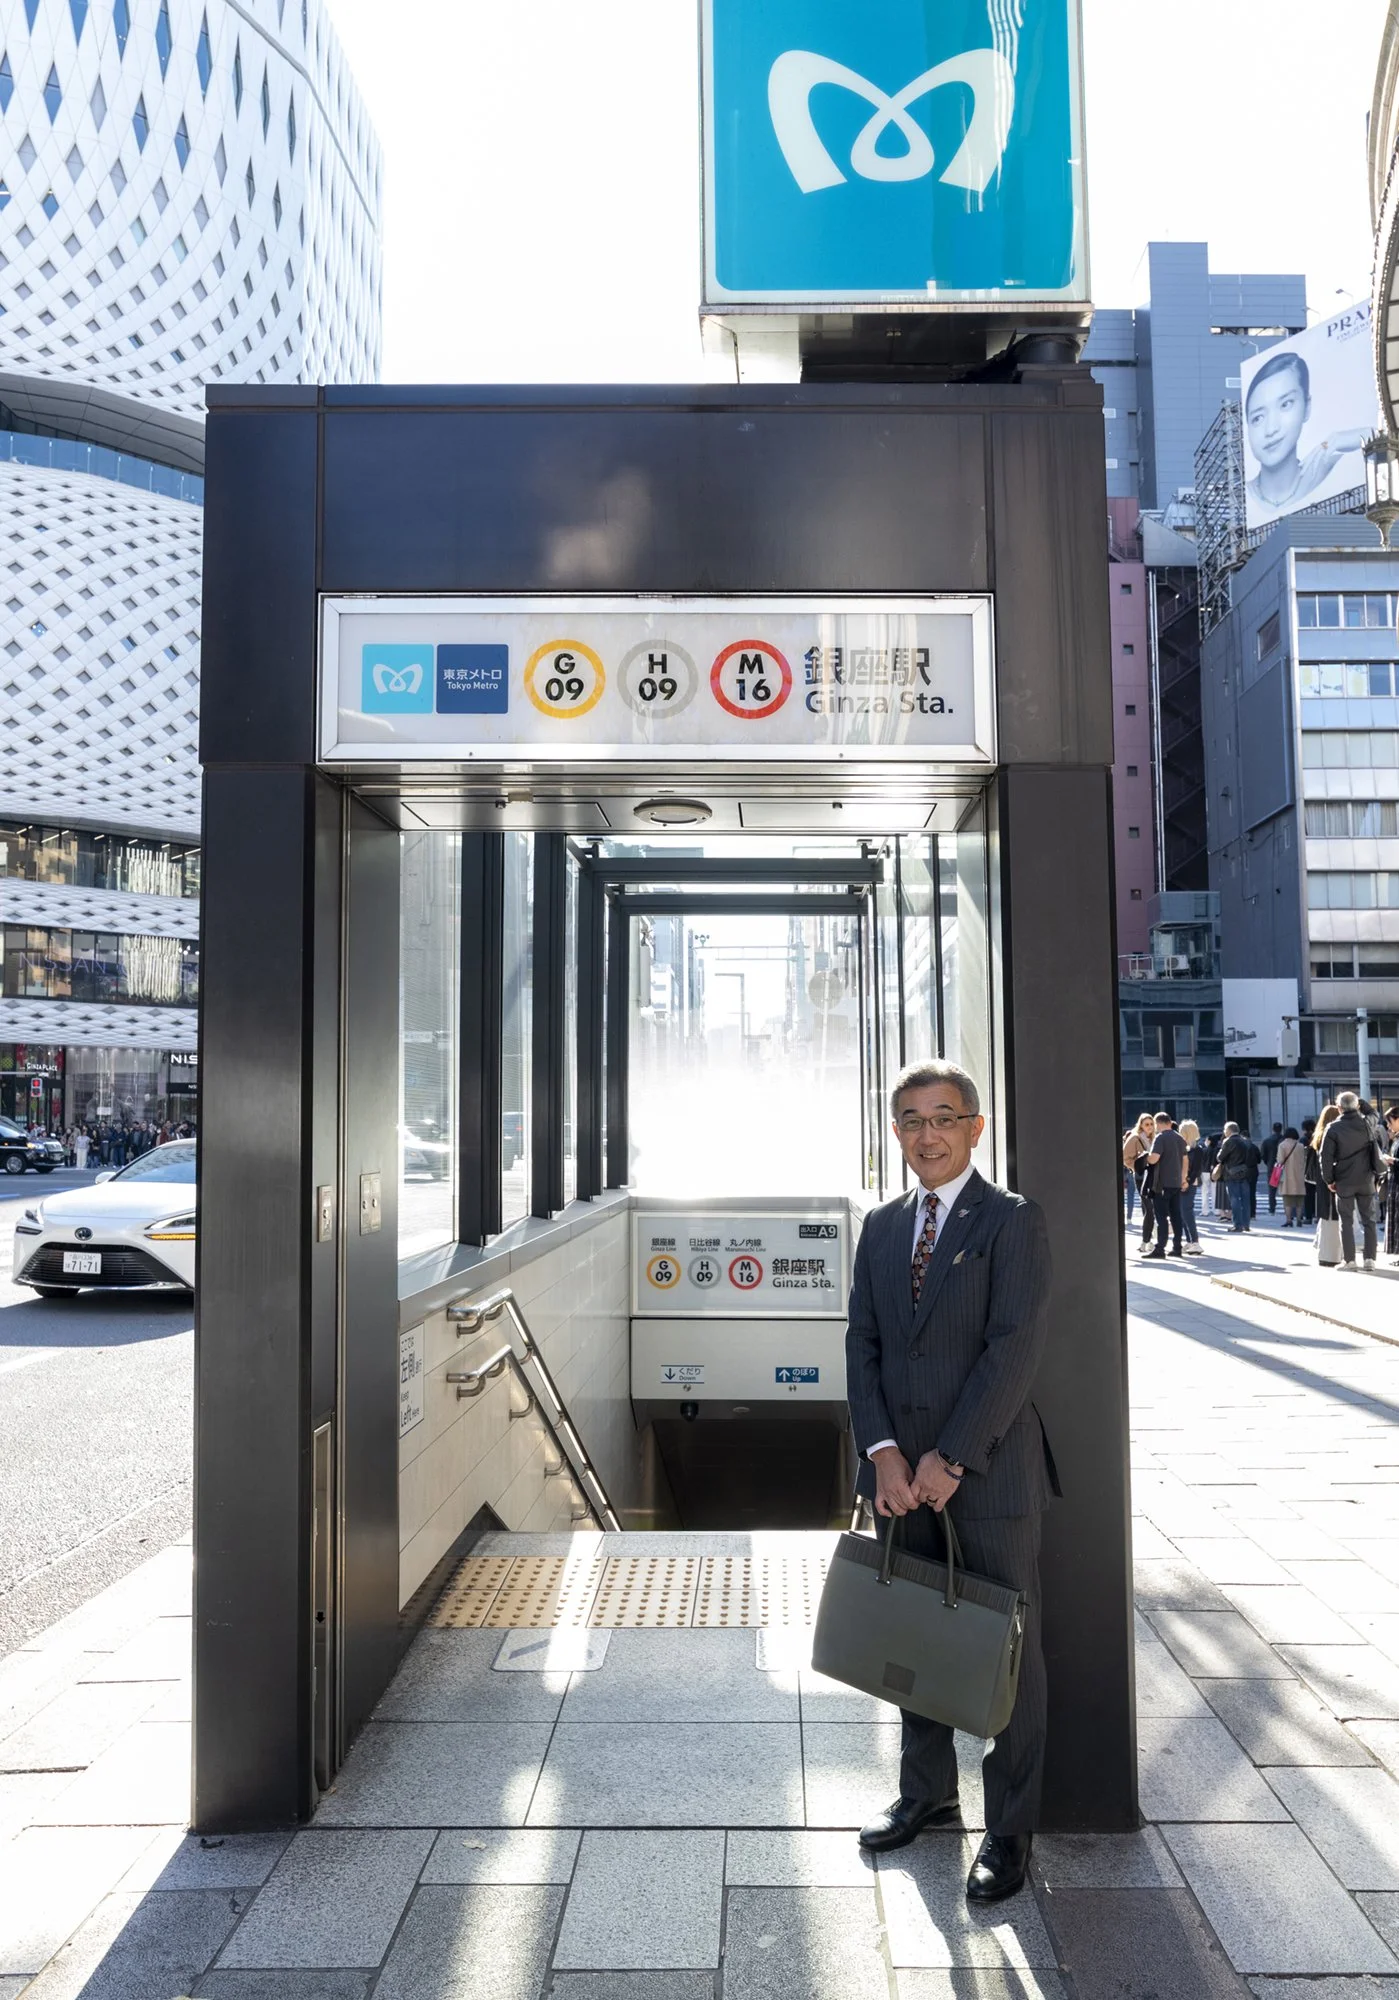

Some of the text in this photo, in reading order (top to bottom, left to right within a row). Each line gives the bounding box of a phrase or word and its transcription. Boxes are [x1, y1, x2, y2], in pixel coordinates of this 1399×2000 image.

[554, 653, 576, 675] G
[648, 653, 668, 674] H
[738, 653, 764, 674] M
[804, 646, 931, 687] 銀座駅
[443, 669, 502, 680] 東京メトロ
[446, 681, 499, 691] Tokyo Metro
[545, 678, 584, 701] 09
[638, 678, 678, 701] 09
[735, 678, 771, 702] 16
[805, 690, 954, 714] Ginza Sta.
[818, 1225, 836, 1237] A9
[651, 1238, 676, 1246] 銀座線
[689, 1238, 720, 1247] 日比谷線
[730, 1238, 762, 1247] 丸ノ内線
[659, 1260, 669, 1270] G
[700, 1261, 709, 1270] H
[740, 1261, 751, 1271] M
[772, 1258, 825, 1276] 銀座駅
[655, 1271, 672, 1282] 09
[696, 1271, 713, 1282] 09
[739, 1272, 754, 1283] 16
[772, 1277, 835, 1288] Ginza Sta.
[679, 1367, 701, 1376] くだり
[792, 1368, 816, 1376] のぼり
